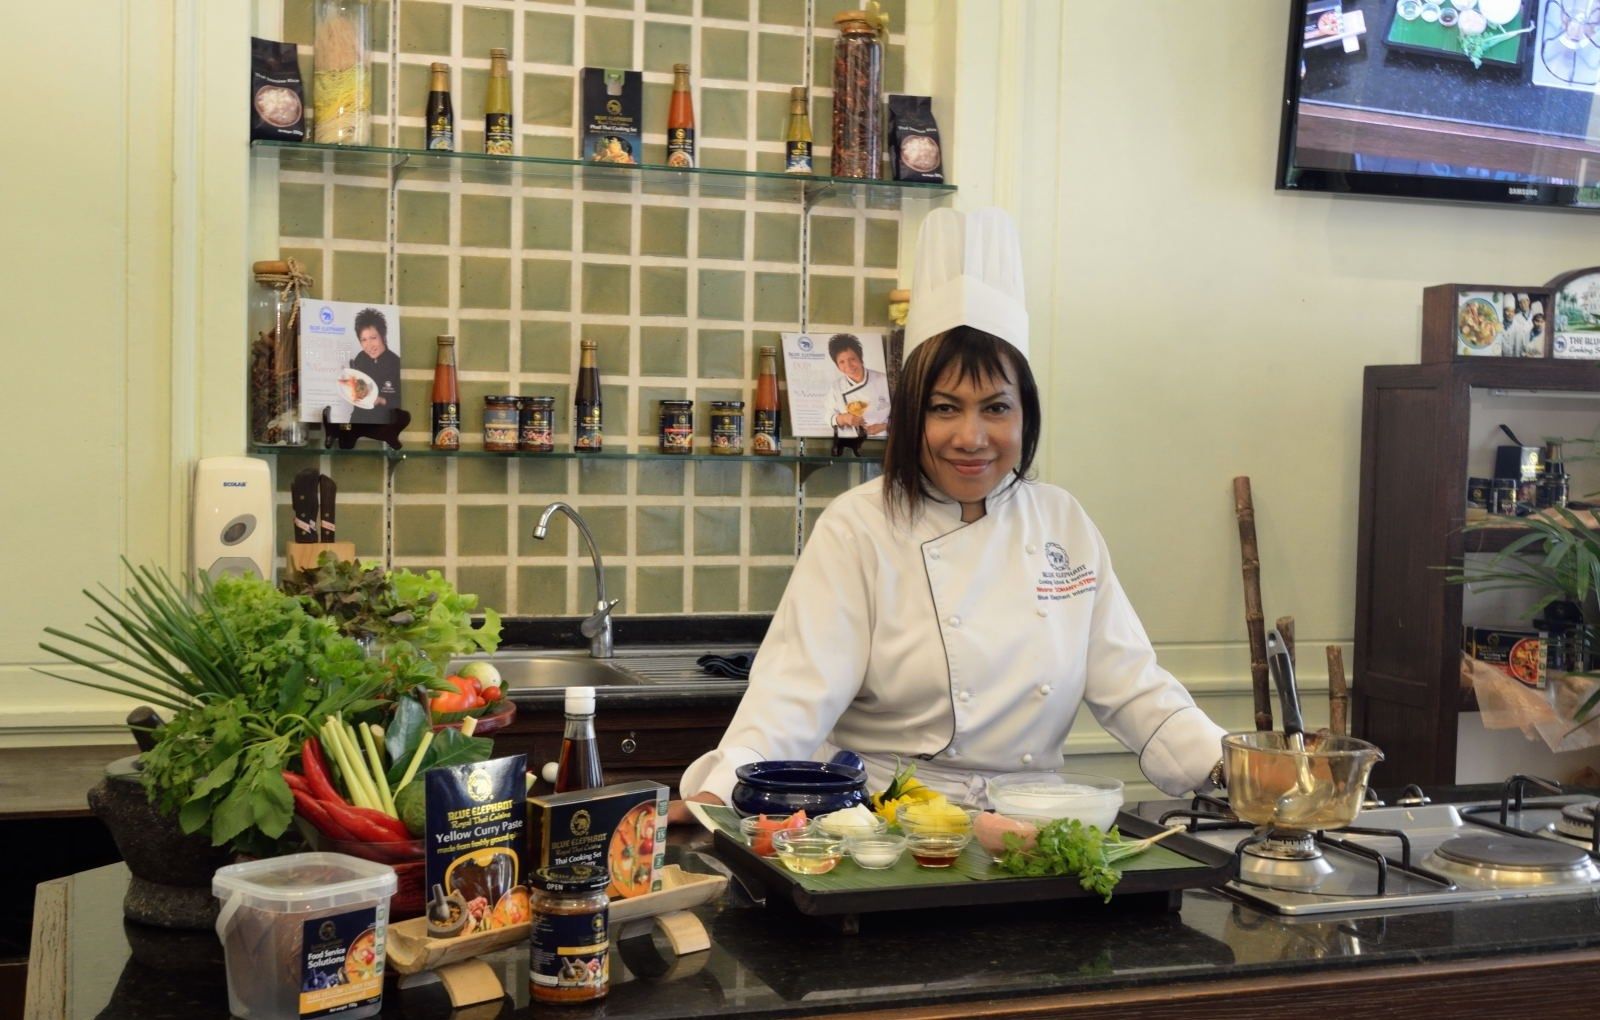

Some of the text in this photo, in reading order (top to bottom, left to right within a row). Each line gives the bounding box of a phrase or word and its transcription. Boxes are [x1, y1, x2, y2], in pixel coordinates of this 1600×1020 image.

[1508, 187, 1538, 196] SAMSUNG
[1569, 336, 1583, 345] THE
[1569, 345, 1593, 355] Cooking
[448, 799, 514, 821] BLUE ELEPHANT
[450, 817, 472, 829] Royal
[473, 815, 489, 825] Thai
[435, 819, 524, 844] Yellow Curry Paste
[571, 832, 608, 846] ELEPHANT
[436, 844, 456, 854] made
[456, 841, 471, 851] from
[555, 851, 602, 866] Thai Cooking Set
[546, 882, 564, 891] OPEN
[308, 947, 346, 960] Food Service
[307, 955, 345, 969] Solutions
